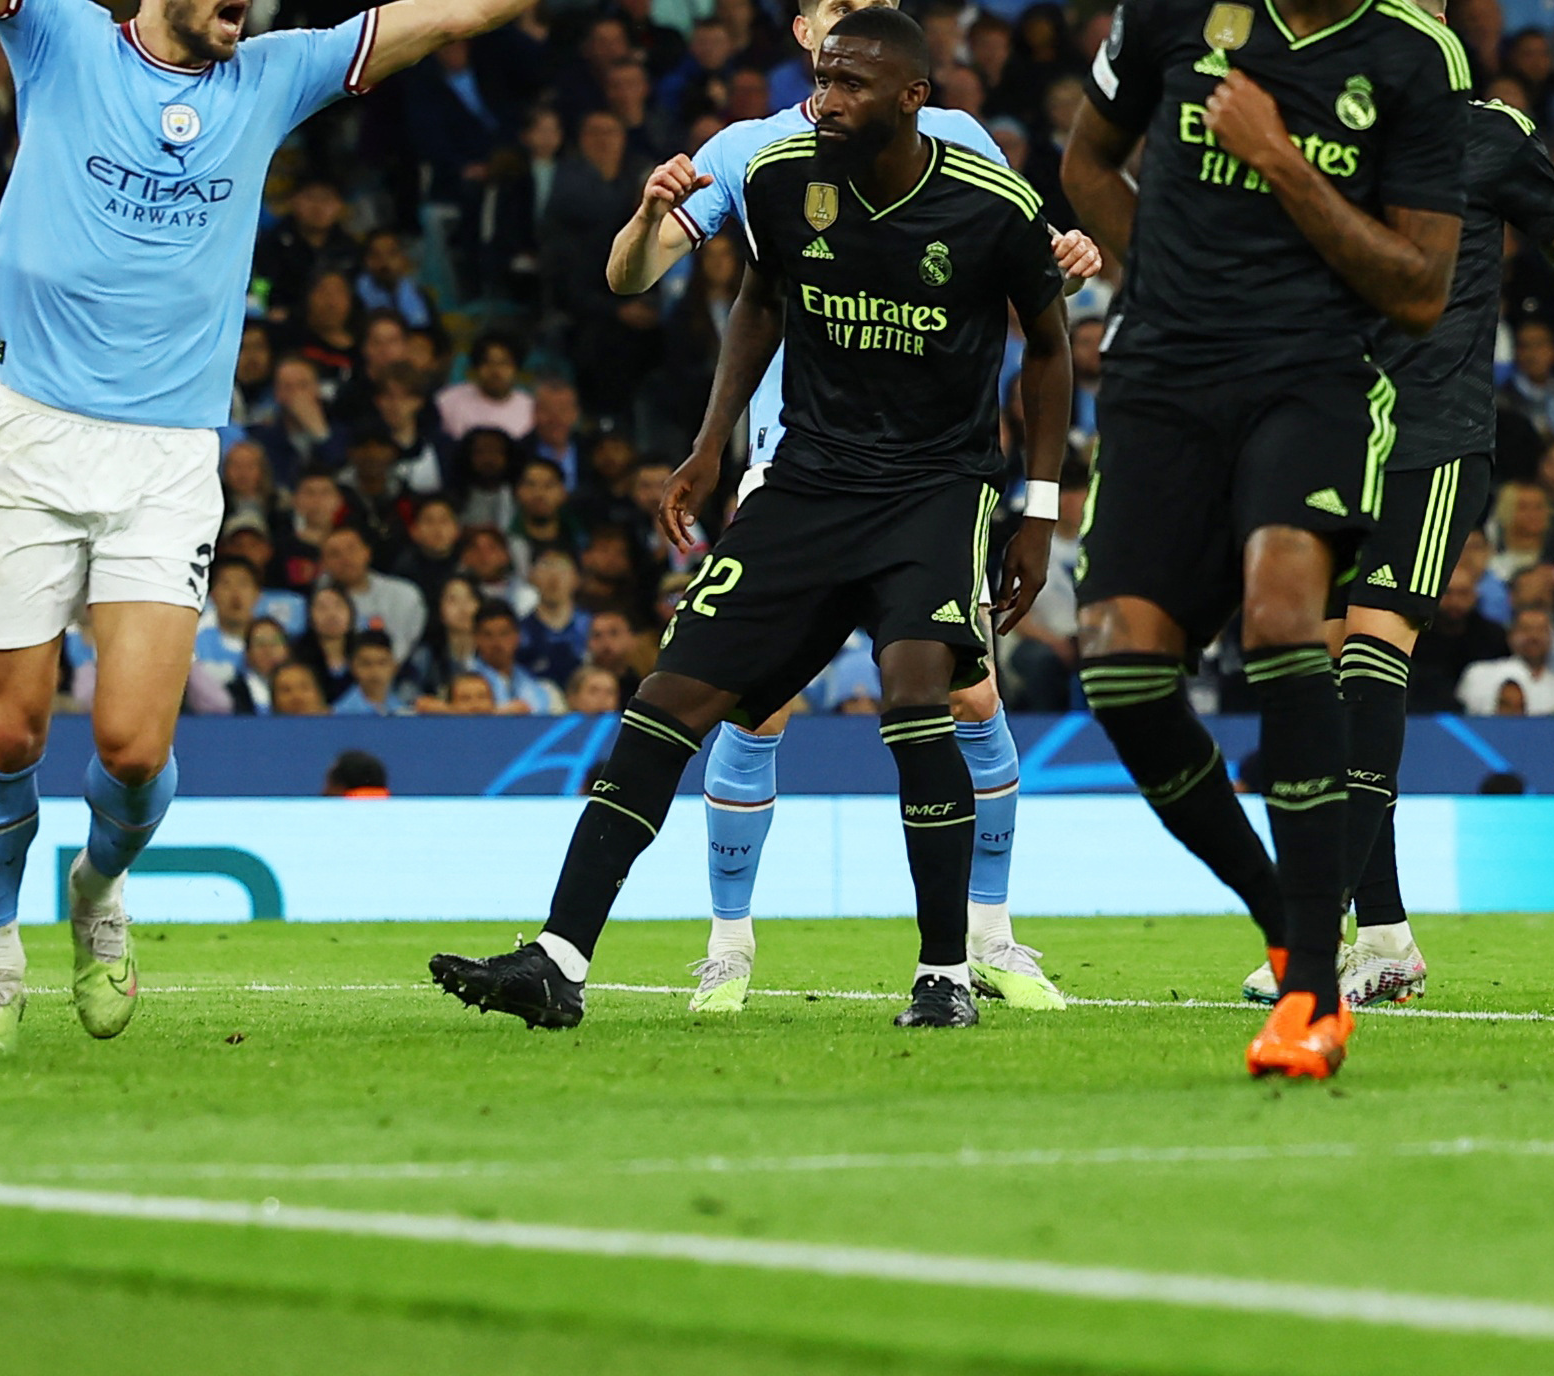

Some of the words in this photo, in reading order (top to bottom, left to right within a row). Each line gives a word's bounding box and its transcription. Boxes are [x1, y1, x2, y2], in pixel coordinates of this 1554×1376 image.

[86, 155, 233, 203] ETIHAD
[104, 198, 209, 227] AIRWAYS
[802, 248, 835, 260] adidas
[800, 283, 948, 331] Emirates
[826, 321, 854, 349] FLY
[859, 325, 925, 356] BETTER
[1346, 768, 1387, 783] MCF
[592, 780, 620, 792] CF
[905, 802, 957, 816] RMCF
[980, 827, 1015, 843] CIT
[711, 841, 751, 856] CITY
